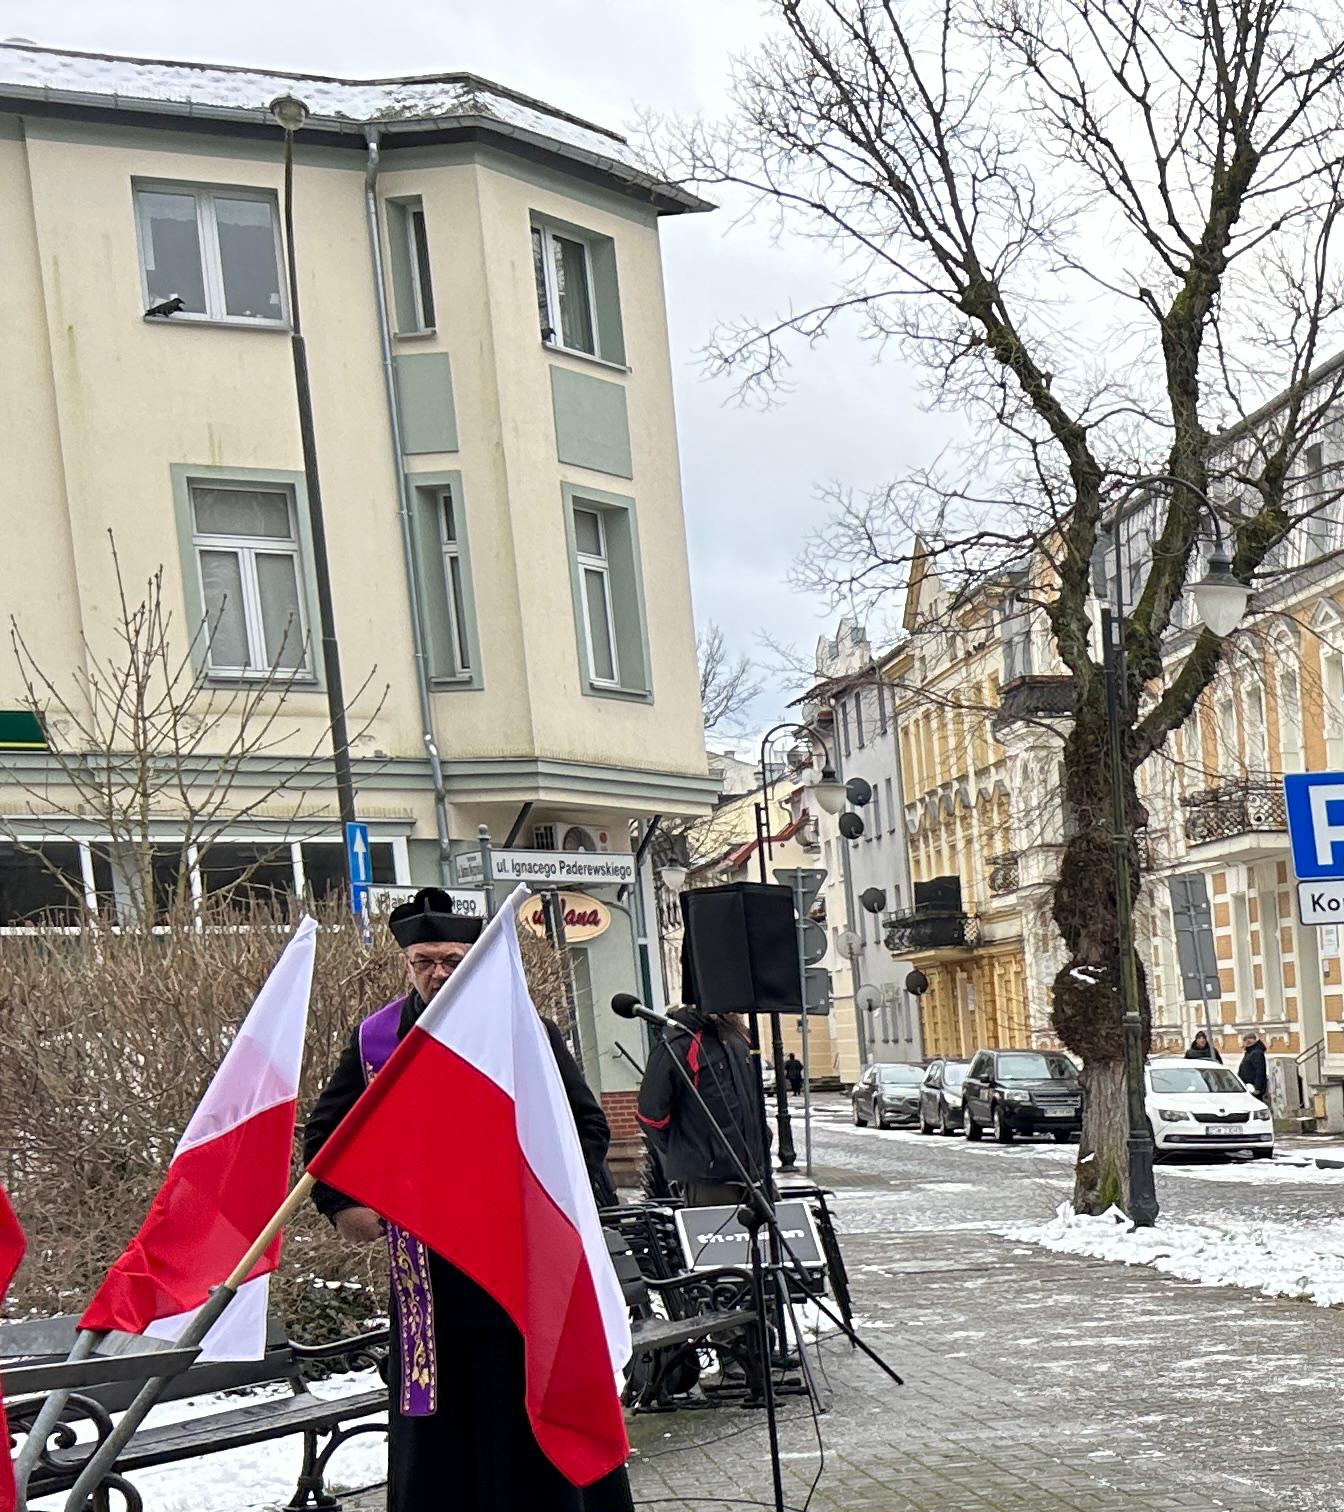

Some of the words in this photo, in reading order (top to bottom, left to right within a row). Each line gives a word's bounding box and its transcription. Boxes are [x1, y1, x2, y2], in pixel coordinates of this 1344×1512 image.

[497, 858, 510, 873] ul.
[511, 858, 557, 878] Ignacego
[558, 860, 632, 880] Paderewskiego
